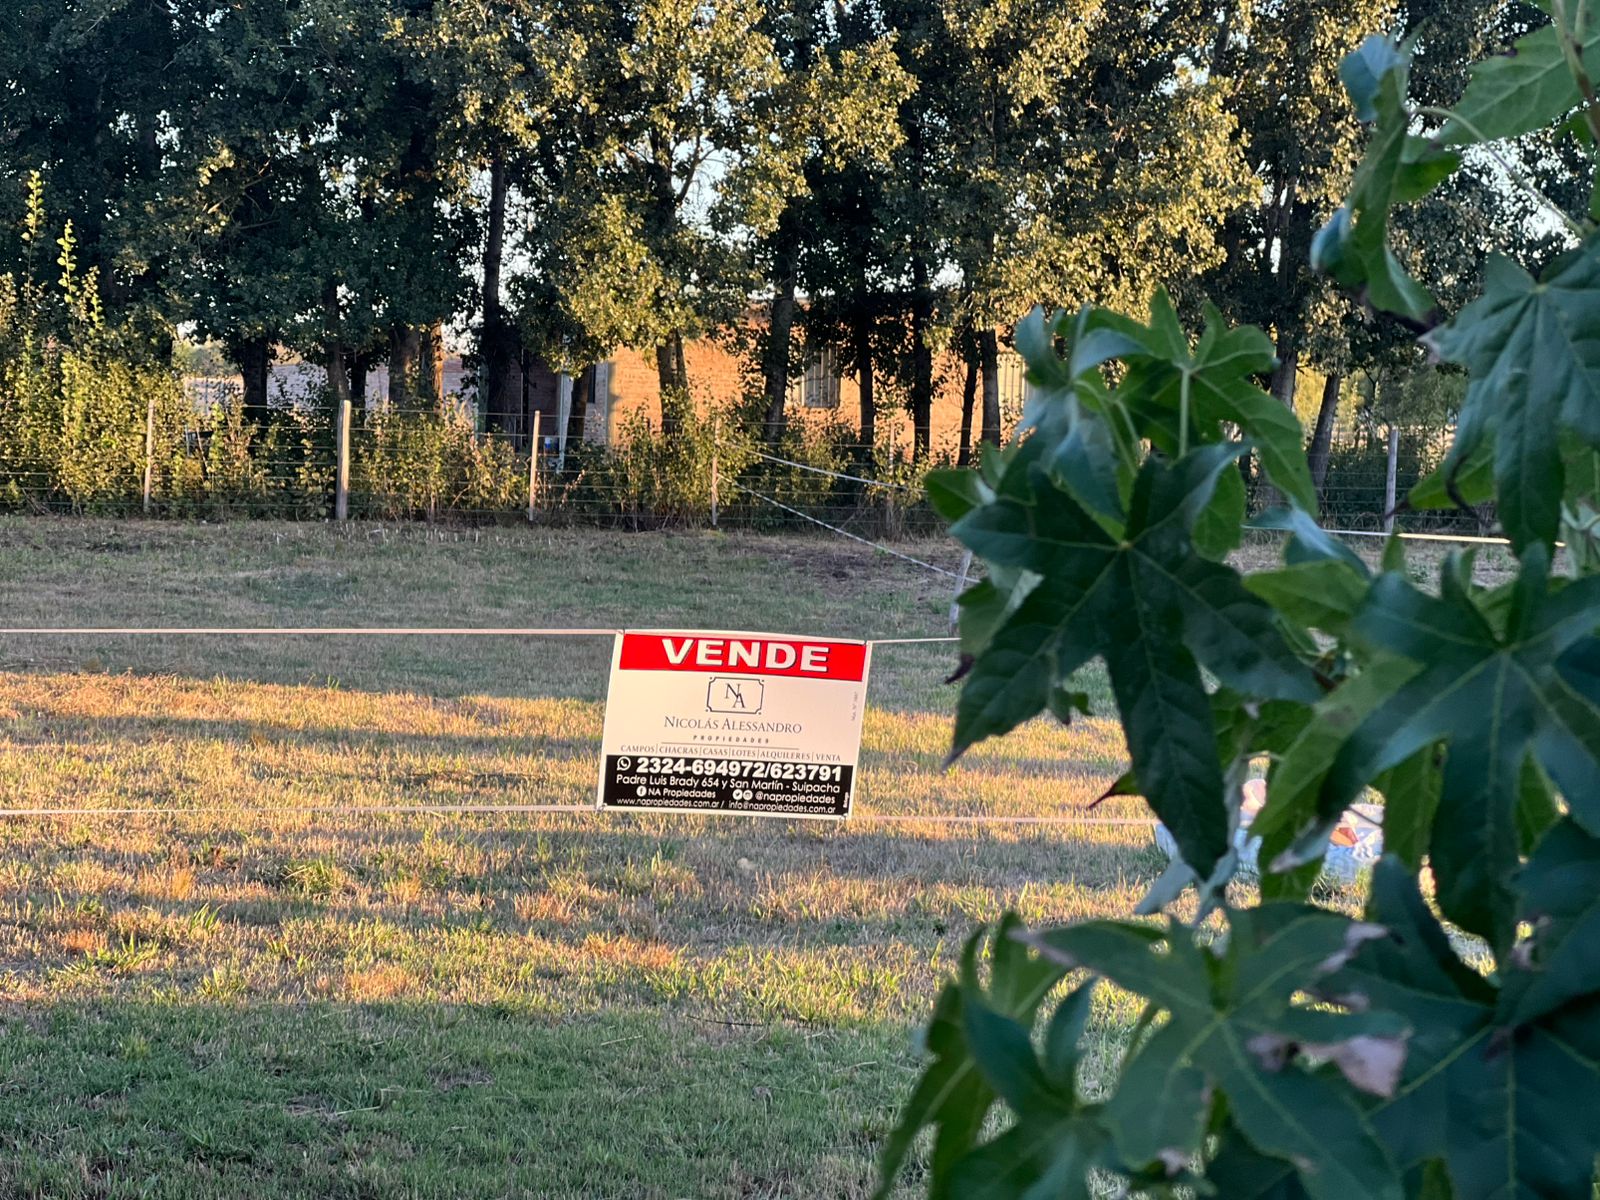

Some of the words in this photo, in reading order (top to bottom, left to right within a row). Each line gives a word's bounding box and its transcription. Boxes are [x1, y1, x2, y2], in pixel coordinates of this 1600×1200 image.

[662, 638, 830, 673] VENDE
[664, 716, 719, 730] NICOLÁS
[721, 717, 802, 734] ALESSANDRO
[693, 734, 770, 744] PROPIEDADES
[620, 744, 655, 753] CAMPOS
[659, 745, 699, 755] CHACRAS
[702, 747, 728, 756] CASAS
[731, 748, 756, 758] LOTES
[760, 750, 811, 760] ALQUILERES
[816, 752, 841, 762] VENTA
[636, 757, 842, 782] 2324-694972/623791
[616, 774, 647, 785] Padre
[649, 775, 667, 786] Luis
[669, 776, 699, 788] Brady
[701, 777, 719, 788] 654
[721, 779, 728, 790] y
[729, 778, 749, 788] San
[751, 780, 784, 790] Martín
[791, 781, 841, 794] Suipacha
[648, 787, 661, 796] NA
[663, 788, 716, 799] Propiedades
[616, 798, 719, 808] www.napropiedades.com.ar
[755, 790, 836, 804] @napropiedades
